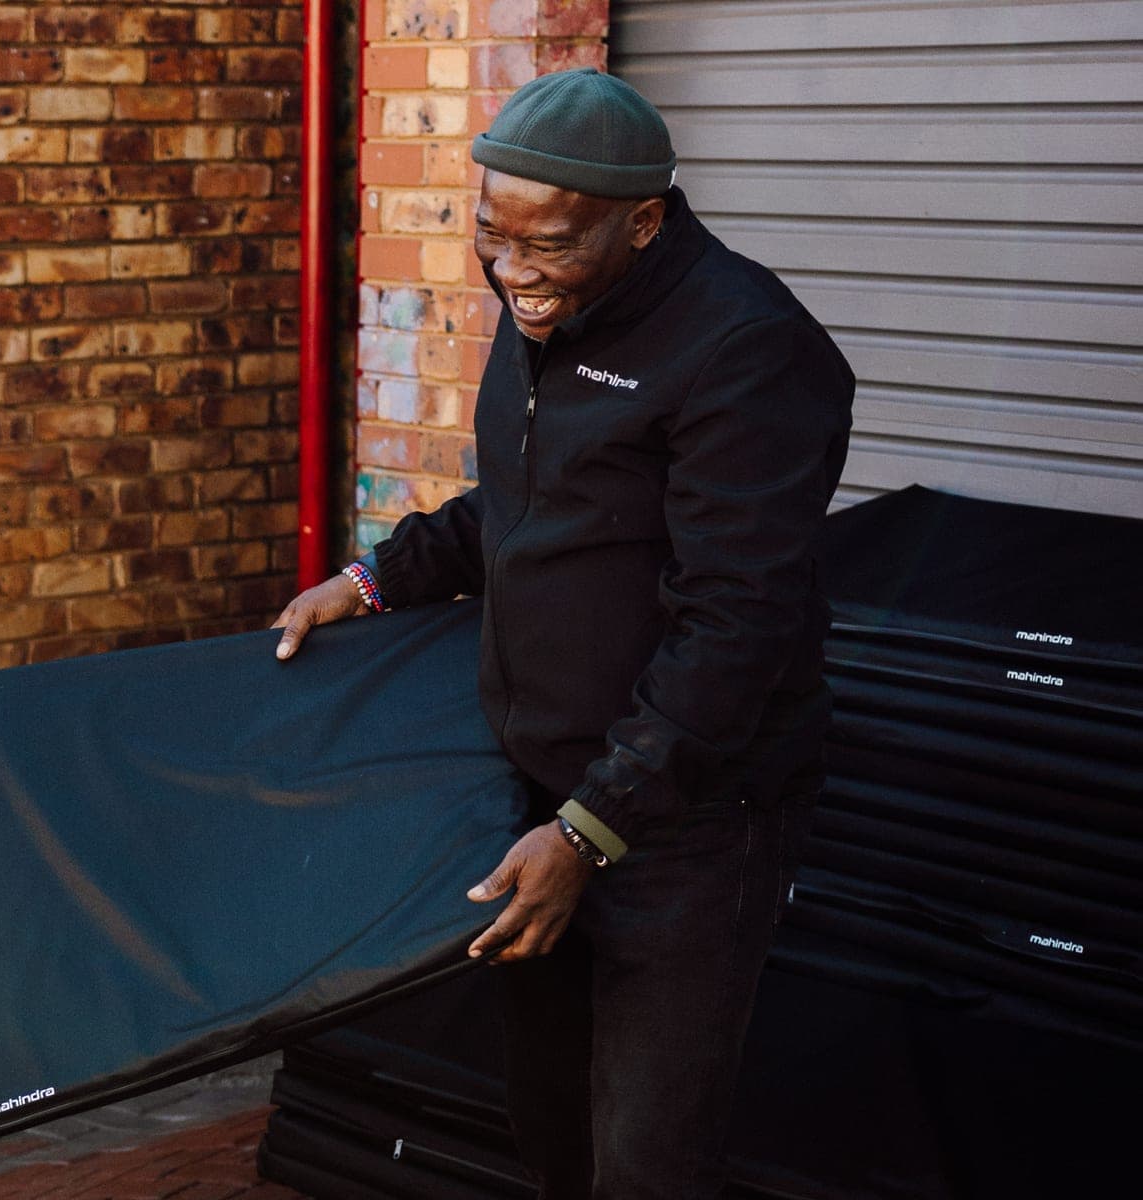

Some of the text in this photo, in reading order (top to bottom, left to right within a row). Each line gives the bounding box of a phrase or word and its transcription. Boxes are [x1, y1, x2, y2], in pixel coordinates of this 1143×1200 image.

[1015, 631, 1073, 645] mahindra
[1006, 670, 1064, 687] mahindra
[1029, 934, 1084, 954] mahindra
